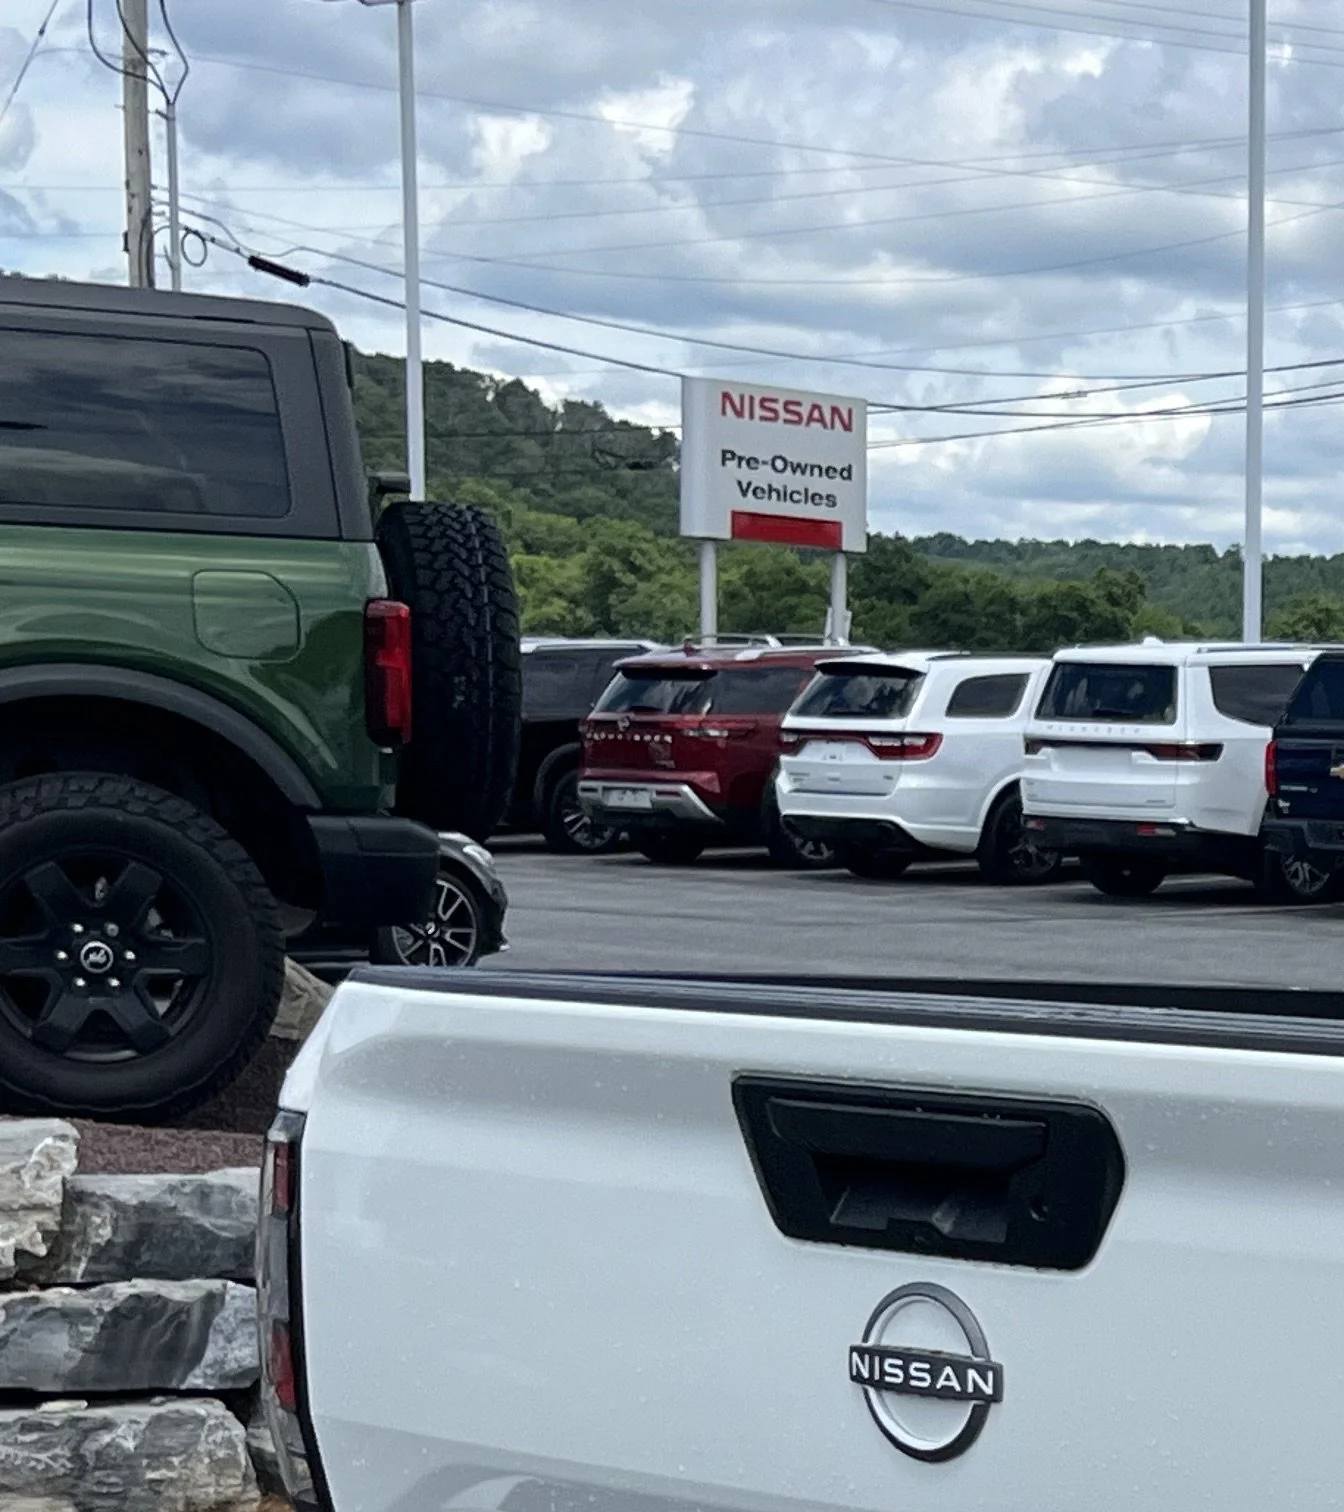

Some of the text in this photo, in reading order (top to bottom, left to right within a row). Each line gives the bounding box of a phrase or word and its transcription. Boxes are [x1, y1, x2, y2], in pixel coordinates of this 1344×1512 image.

[720, 391, 853, 432] NISSAN
[720, 449, 853, 481] Pre-Owned
[737, 480, 837, 508] Vehicles
[850, 1351, 994, 1395] NISSAN
